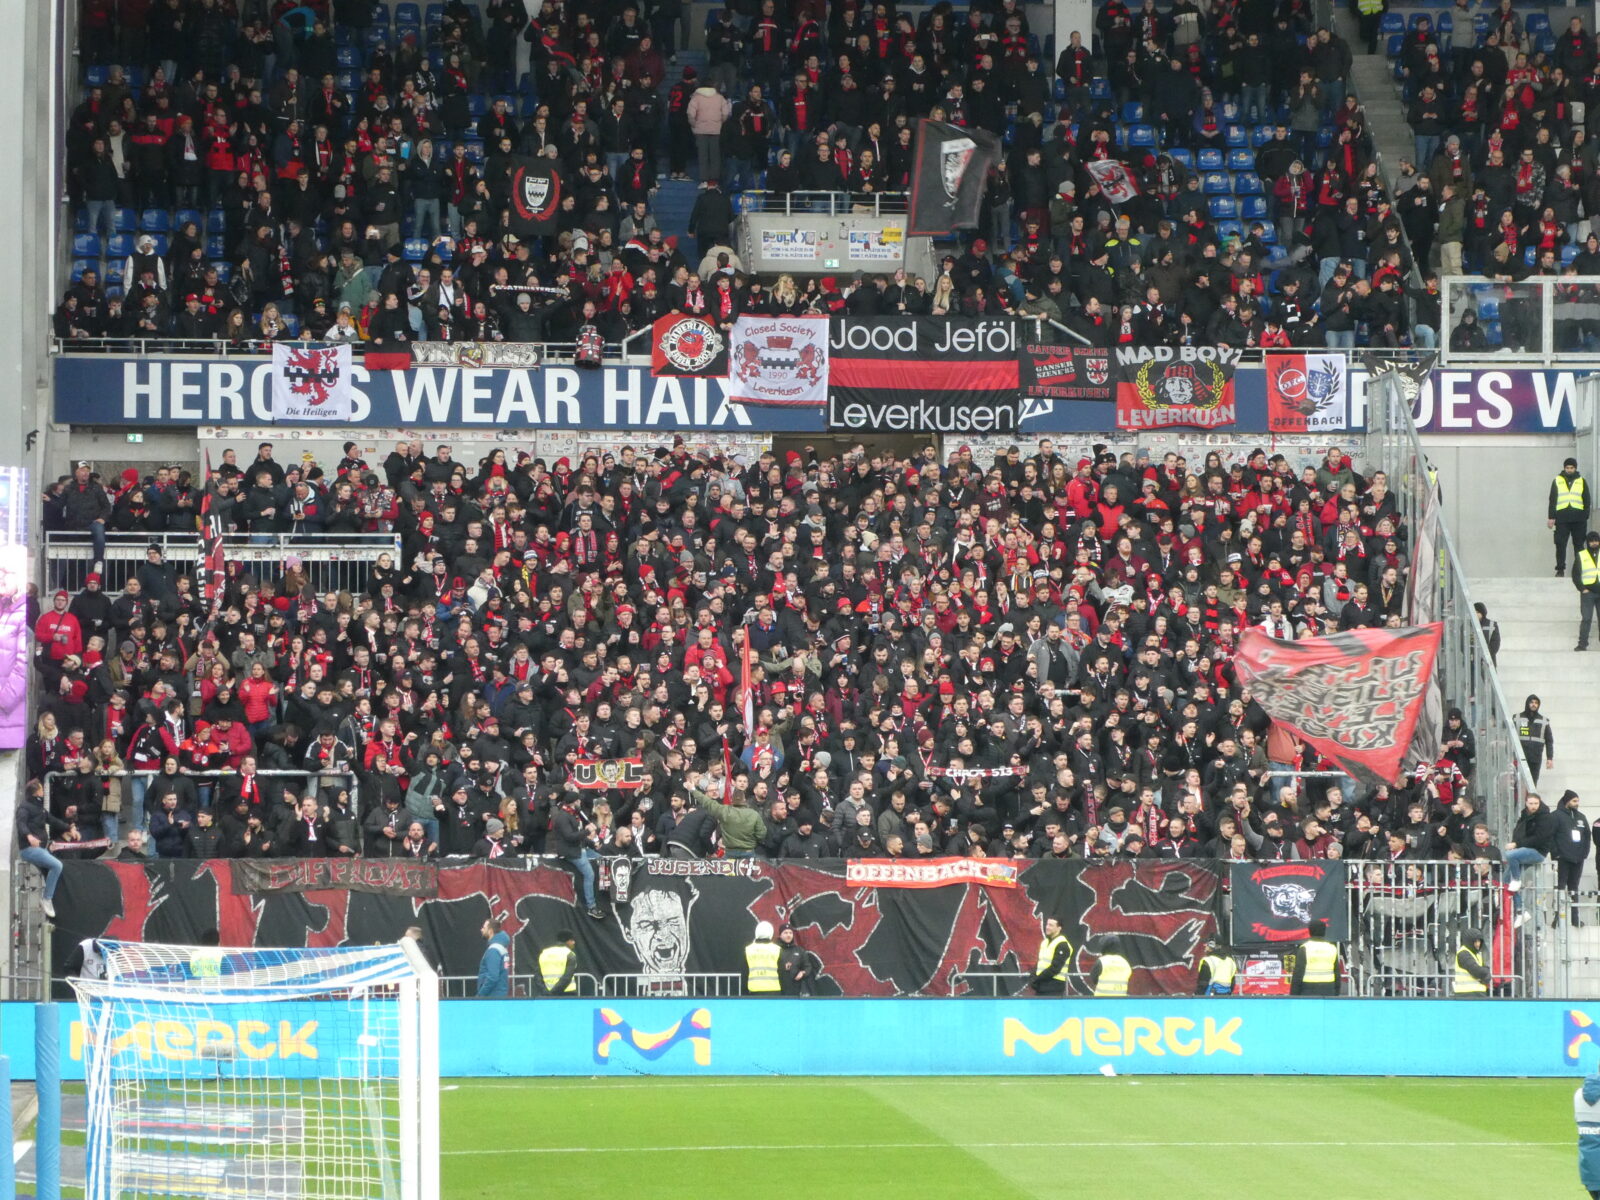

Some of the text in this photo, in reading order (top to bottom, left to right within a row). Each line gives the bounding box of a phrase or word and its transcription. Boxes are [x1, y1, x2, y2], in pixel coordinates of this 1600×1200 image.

[745, 323, 816, 340] Closed Society
[830, 318, 1016, 352] Jood Jeföl
[1115, 346, 1174, 367] MAD
[768, 371, 788, 380] 1990
[1035, 361, 1074, 374] GANSER
[391, 367, 581, 424] WEAR
[603, 369, 752, 425] HAIX
[753, 382, 804, 396] Leverkusen
[1028, 386, 1110, 398] LEVERKUSEN
[286, 406, 338, 419] Die Heiligen
[829, 395, 1014, 431] Leverkusen
[1274, 416, 1343, 427] OFFENBACH
[648, 858, 736, 877] JUGEND
[851, 861, 982, 882] OFFENBACH
